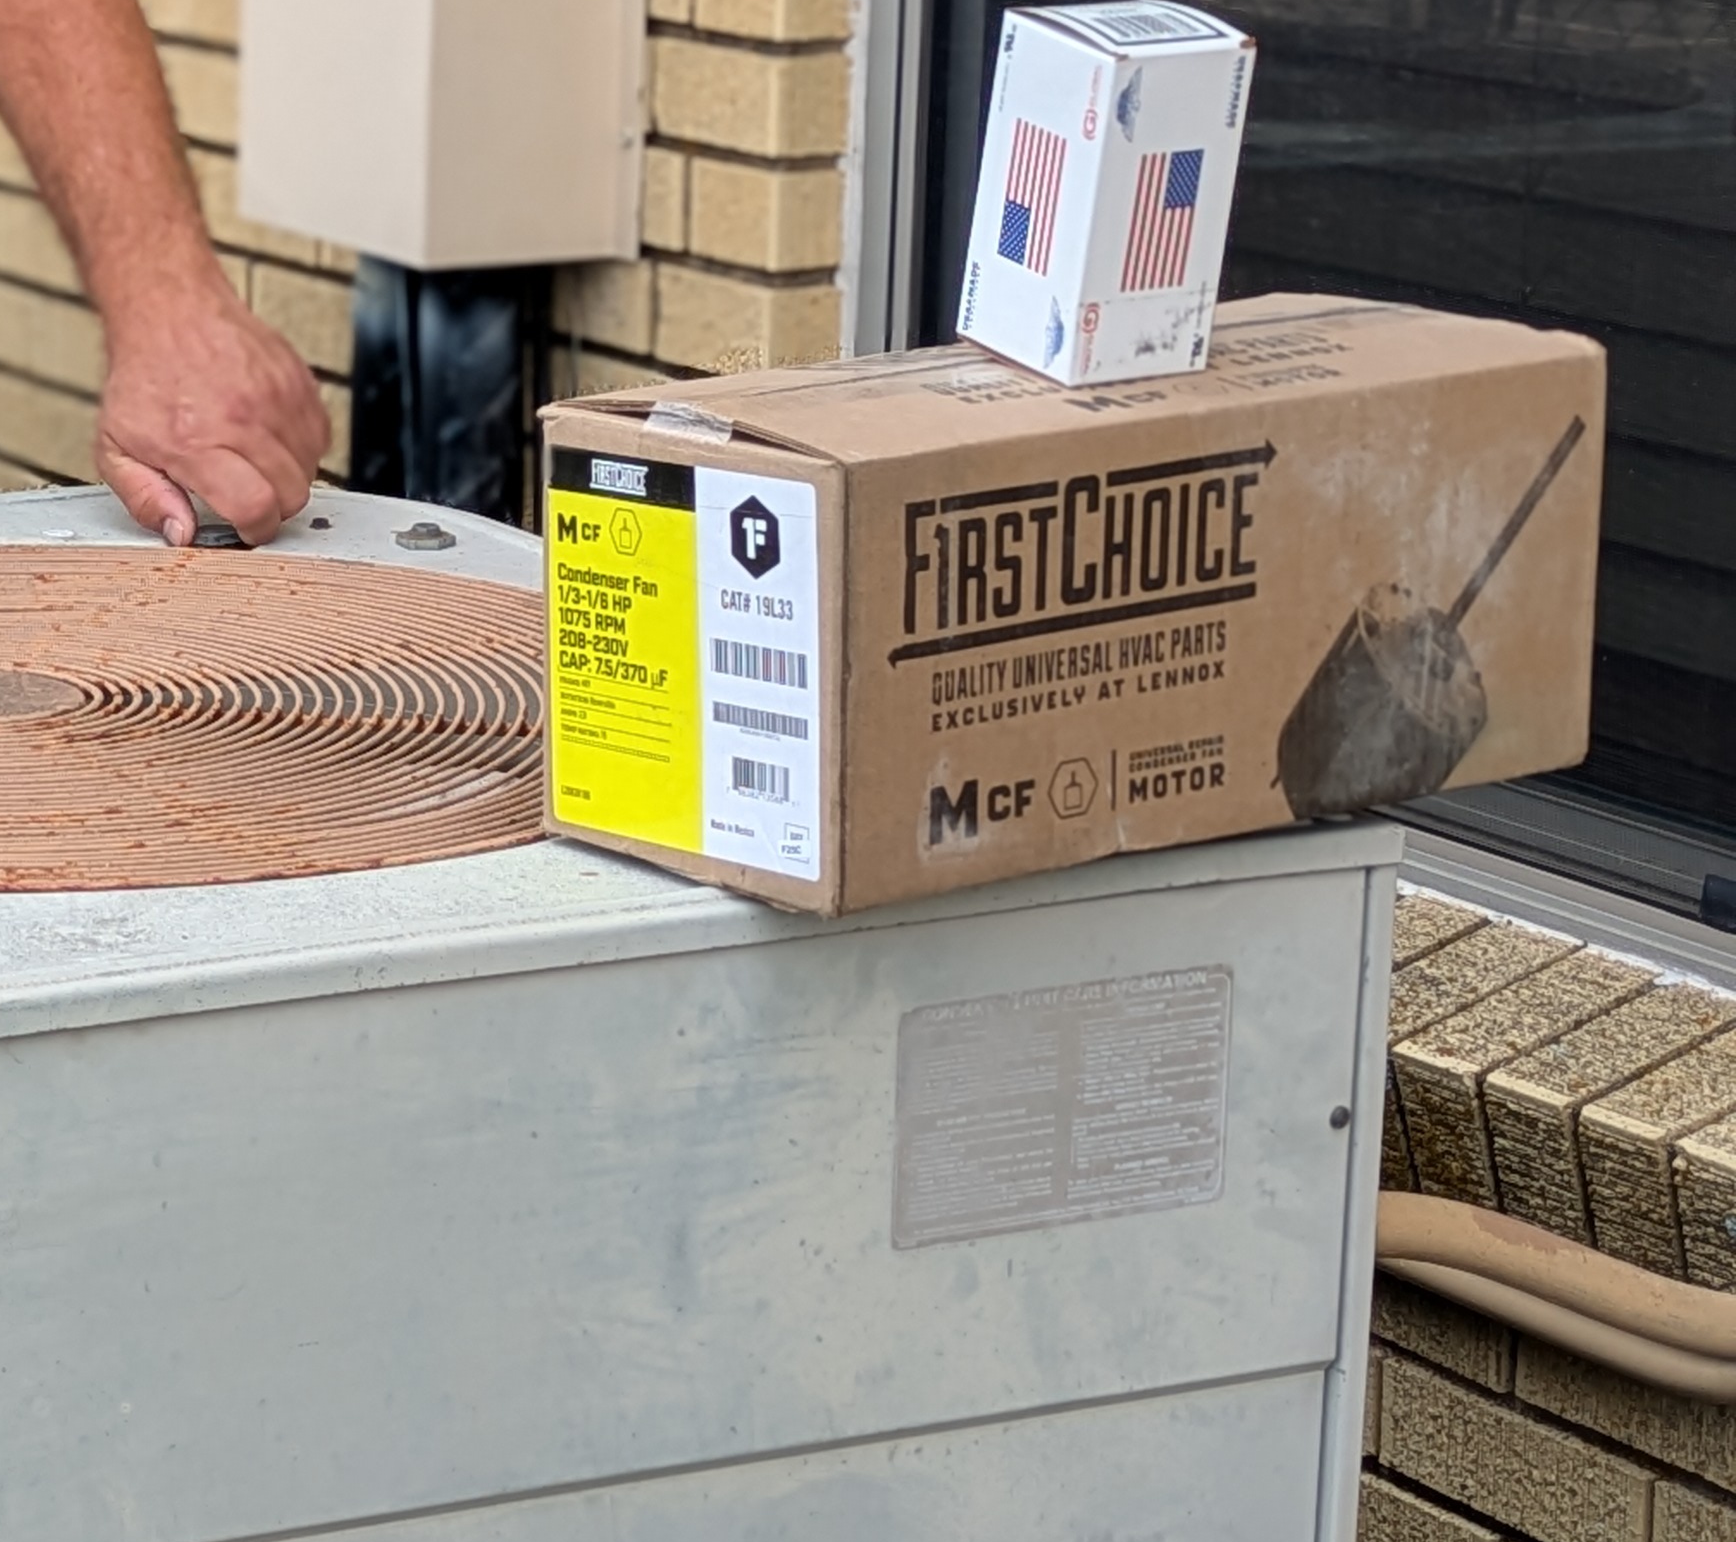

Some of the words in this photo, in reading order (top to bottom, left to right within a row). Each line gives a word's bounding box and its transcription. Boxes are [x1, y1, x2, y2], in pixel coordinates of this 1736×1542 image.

[557, 562, 630, 592] Condenser
[633, 575, 658, 598] Fan
[558, 584, 609, 610] 1/3-1/6
[612, 593, 632, 614] HP
[721, 588, 751, 614] CAT#
[755, 594, 794, 622] 19L33
[558, 606, 591, 629] 1075
[595, 612, 626, 636] RPM
[559, 627, 629, 658] 208-230V
[559, 650, 592, 674] CAP:
[931, 658, 1008, 706] QUALITY
[1012, 640, 1114, 689] UNIVERSAL
[1118, 631, 1167, 669] HVAC
[1170, 620, 1227, 662] PARTS
[930, 684, 1087, 733] EXCLUSIVELY
[1097, 678, 1125, 703] AT
[1136, 661, 1226, 695] LENNOX
[1129, 762, 1225, 805] MOTOR
[929, 779, 1036, 846] MCF
